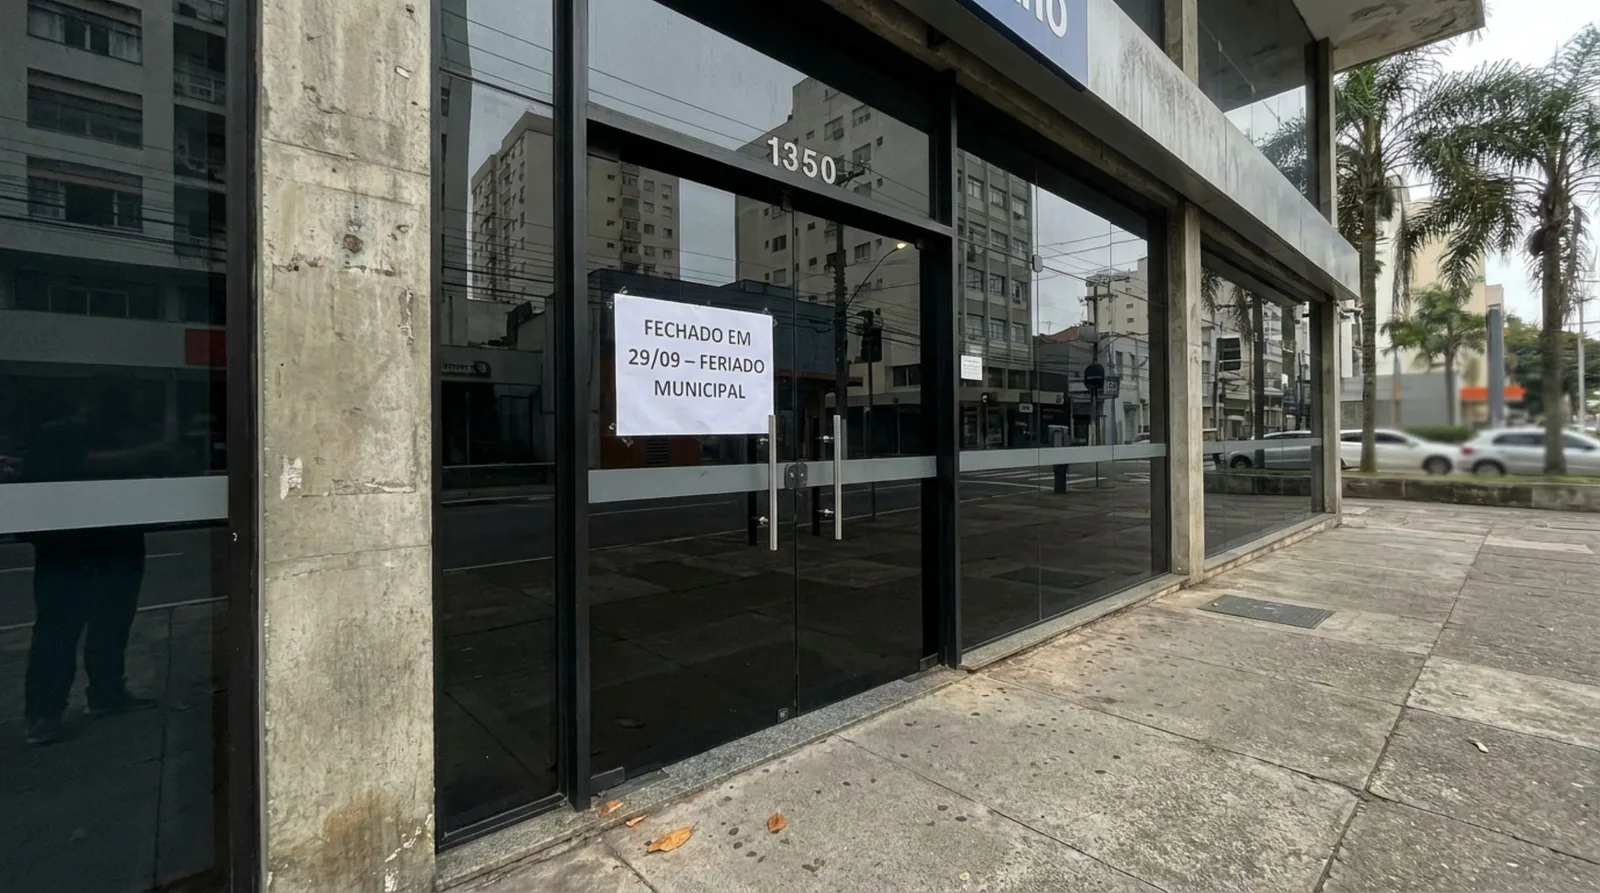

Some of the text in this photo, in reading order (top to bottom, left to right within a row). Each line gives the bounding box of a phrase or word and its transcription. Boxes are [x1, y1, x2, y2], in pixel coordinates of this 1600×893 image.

[767, 136, 837, 185] 1350
[644, 319, 751, 346] FECHADO EM
[628, 348, 681, 370] 29/09
[700, 354, 765, 374] FERIADO
[654, 380, 746, 399] MUNICIPAL
